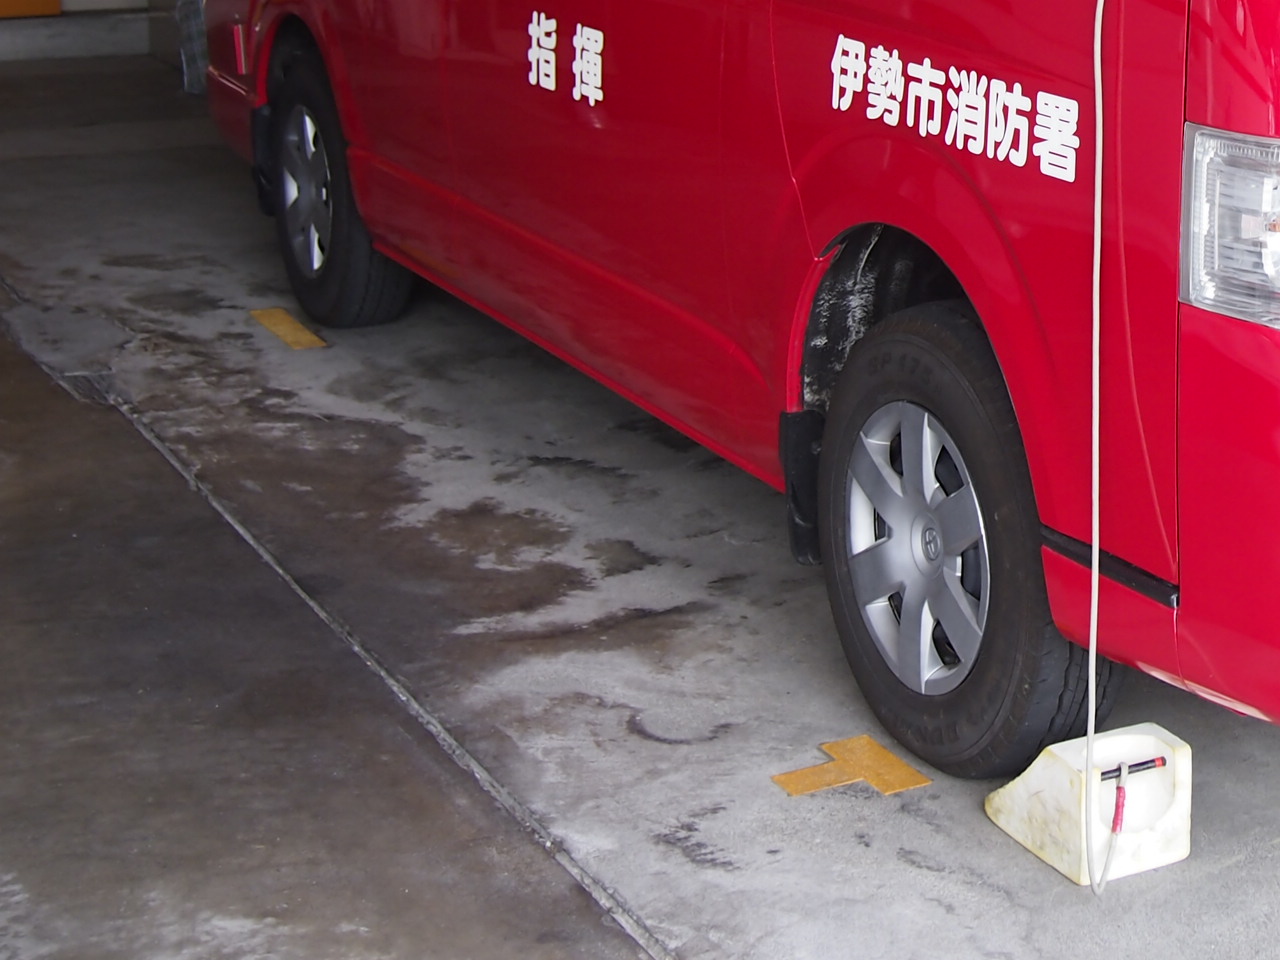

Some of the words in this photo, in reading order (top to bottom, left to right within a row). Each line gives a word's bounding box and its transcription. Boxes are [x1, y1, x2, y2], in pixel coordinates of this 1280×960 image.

[527, 10, 605, 108] 指揮
[830, 33, 1081, 184] 伊勢市消防署
